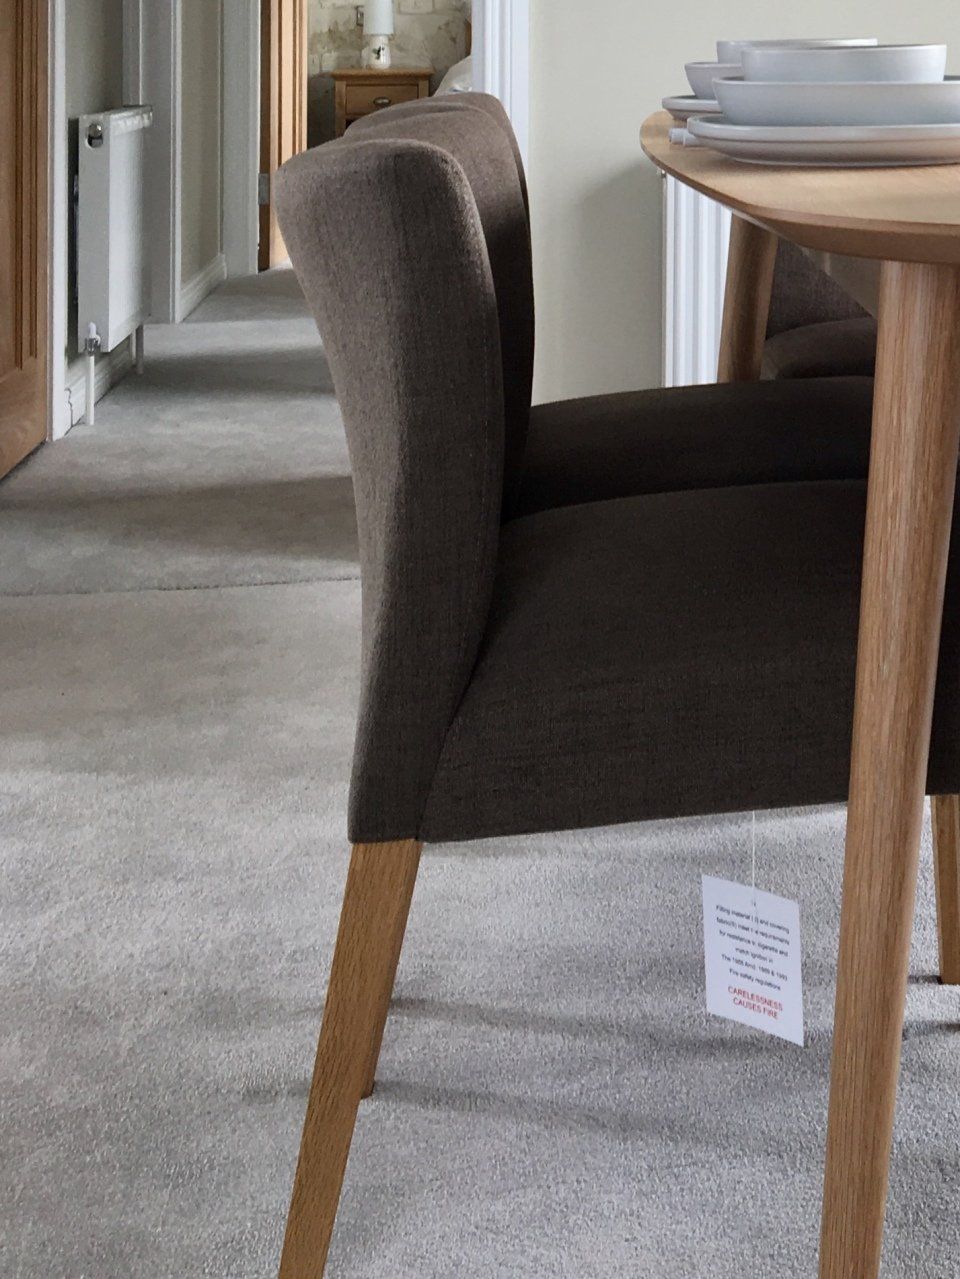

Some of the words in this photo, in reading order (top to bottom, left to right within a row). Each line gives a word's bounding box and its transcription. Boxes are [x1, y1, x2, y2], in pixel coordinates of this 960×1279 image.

[728, 986, 783, 1011] CARELESSNESS
[733, 997, 762, 1014] CAUSES
[763, 1007, 778, 1018] FIRE
